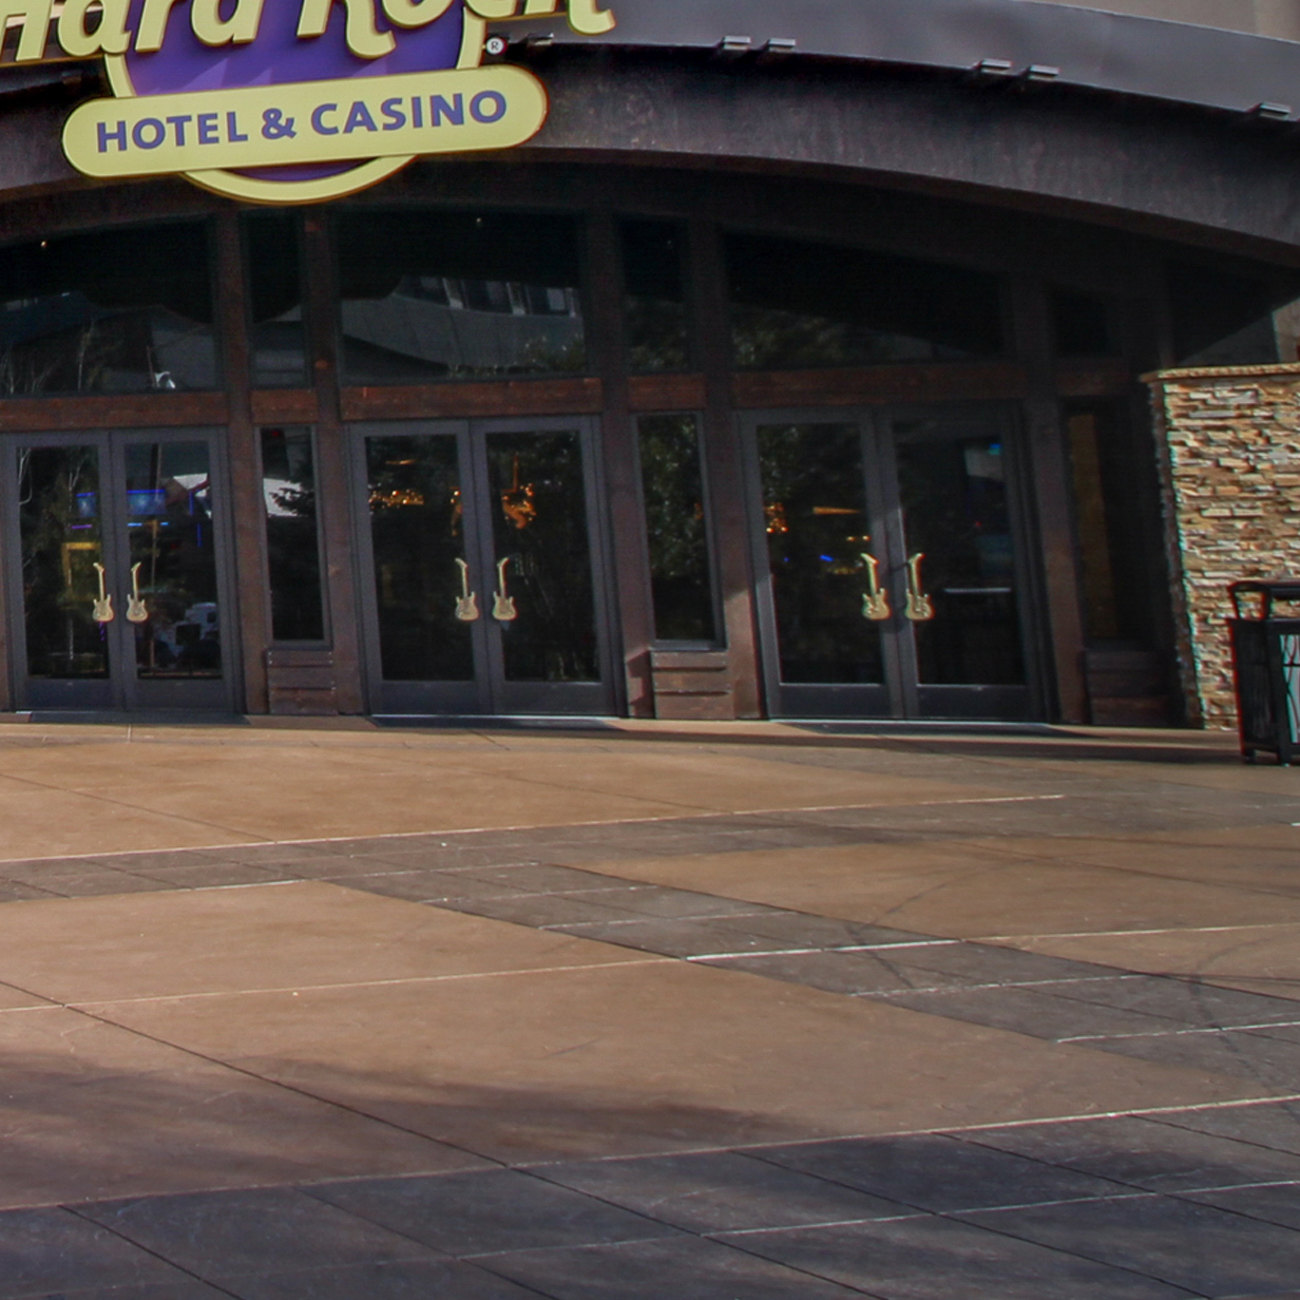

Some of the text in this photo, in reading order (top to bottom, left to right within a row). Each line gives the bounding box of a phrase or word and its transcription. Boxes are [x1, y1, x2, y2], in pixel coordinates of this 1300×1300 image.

[96, 90, 508, 153] HOTEL & CASINO
